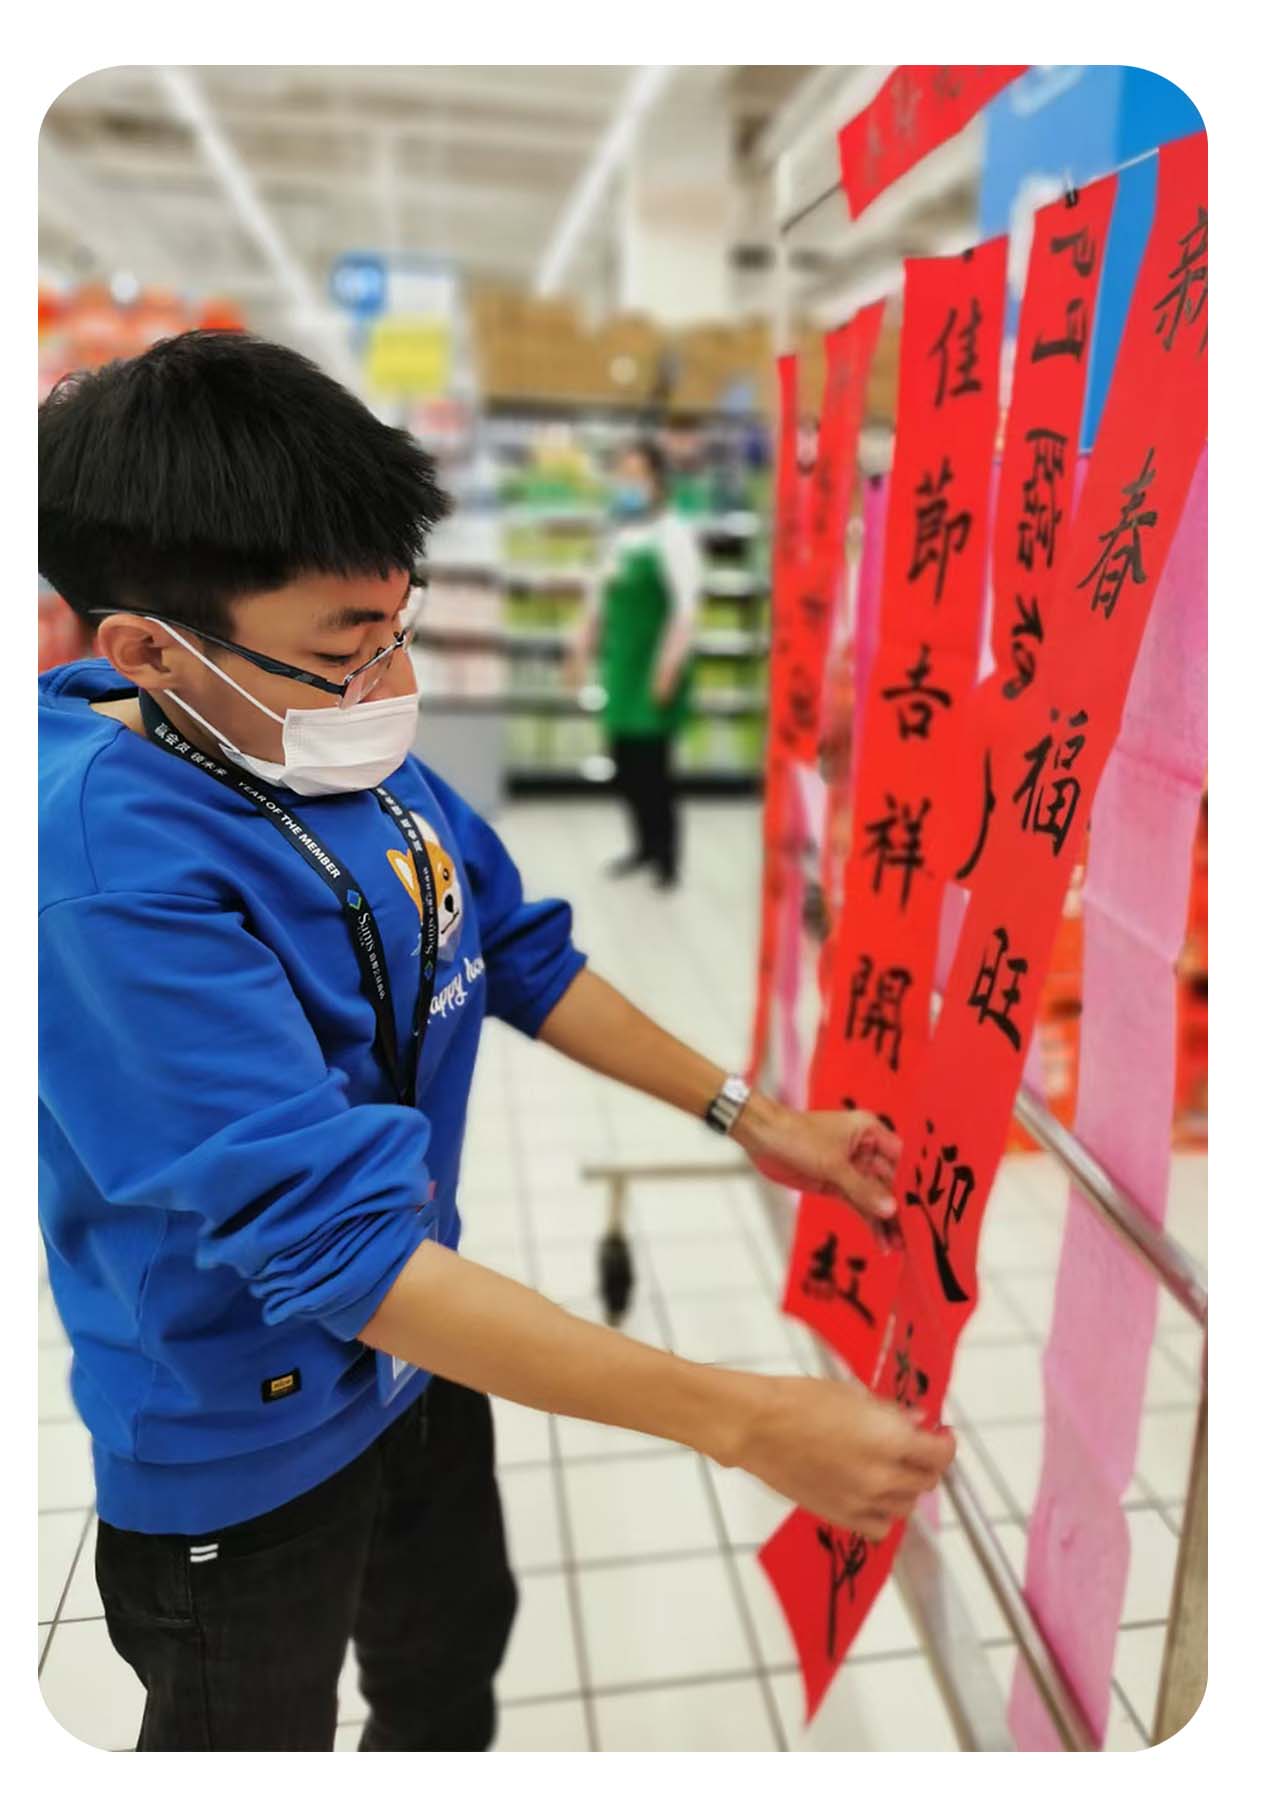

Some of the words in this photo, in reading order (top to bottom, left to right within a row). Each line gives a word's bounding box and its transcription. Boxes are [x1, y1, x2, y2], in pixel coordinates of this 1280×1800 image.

[237, 782, 267, 803] YEAR
[266, 801, 286, 816] OF
[280, 813, 304, 836] THE
[299, 833, 341, 879] MEMBER
[802, 298, 982, 1328] 佳節吉祥開紅
[429, 973, 468, 1018] appy
